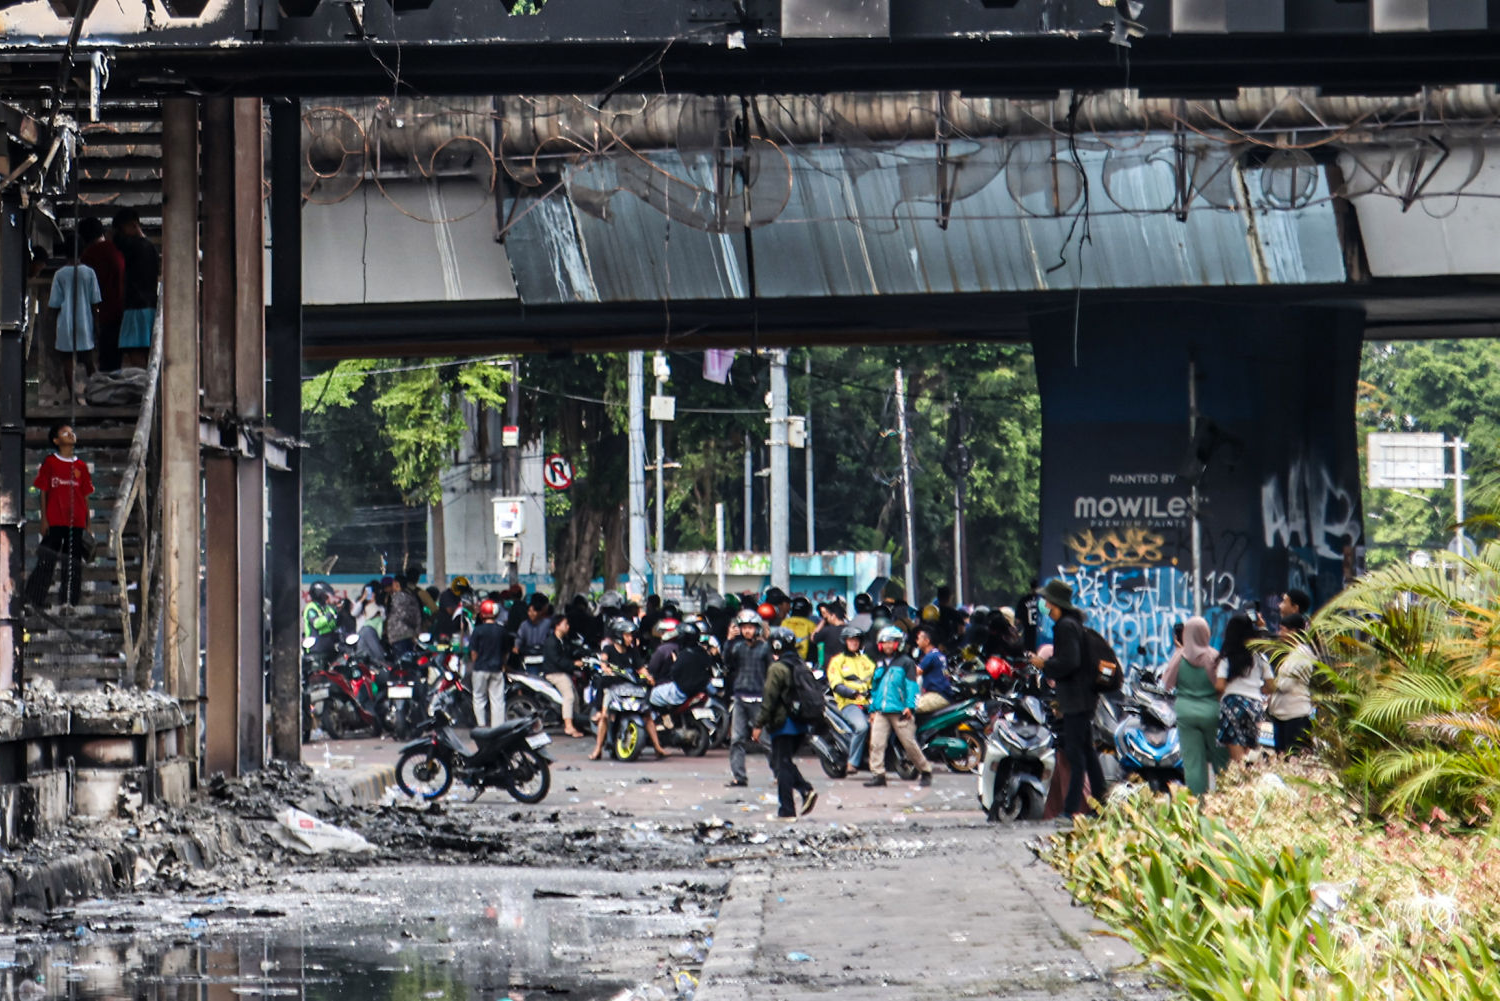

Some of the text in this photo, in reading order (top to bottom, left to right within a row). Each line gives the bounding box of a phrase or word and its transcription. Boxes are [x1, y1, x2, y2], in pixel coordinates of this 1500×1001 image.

[1108, 473, 1177, 485] PAINTED BY
[1147, 520, 1187, 528] PAINTS
